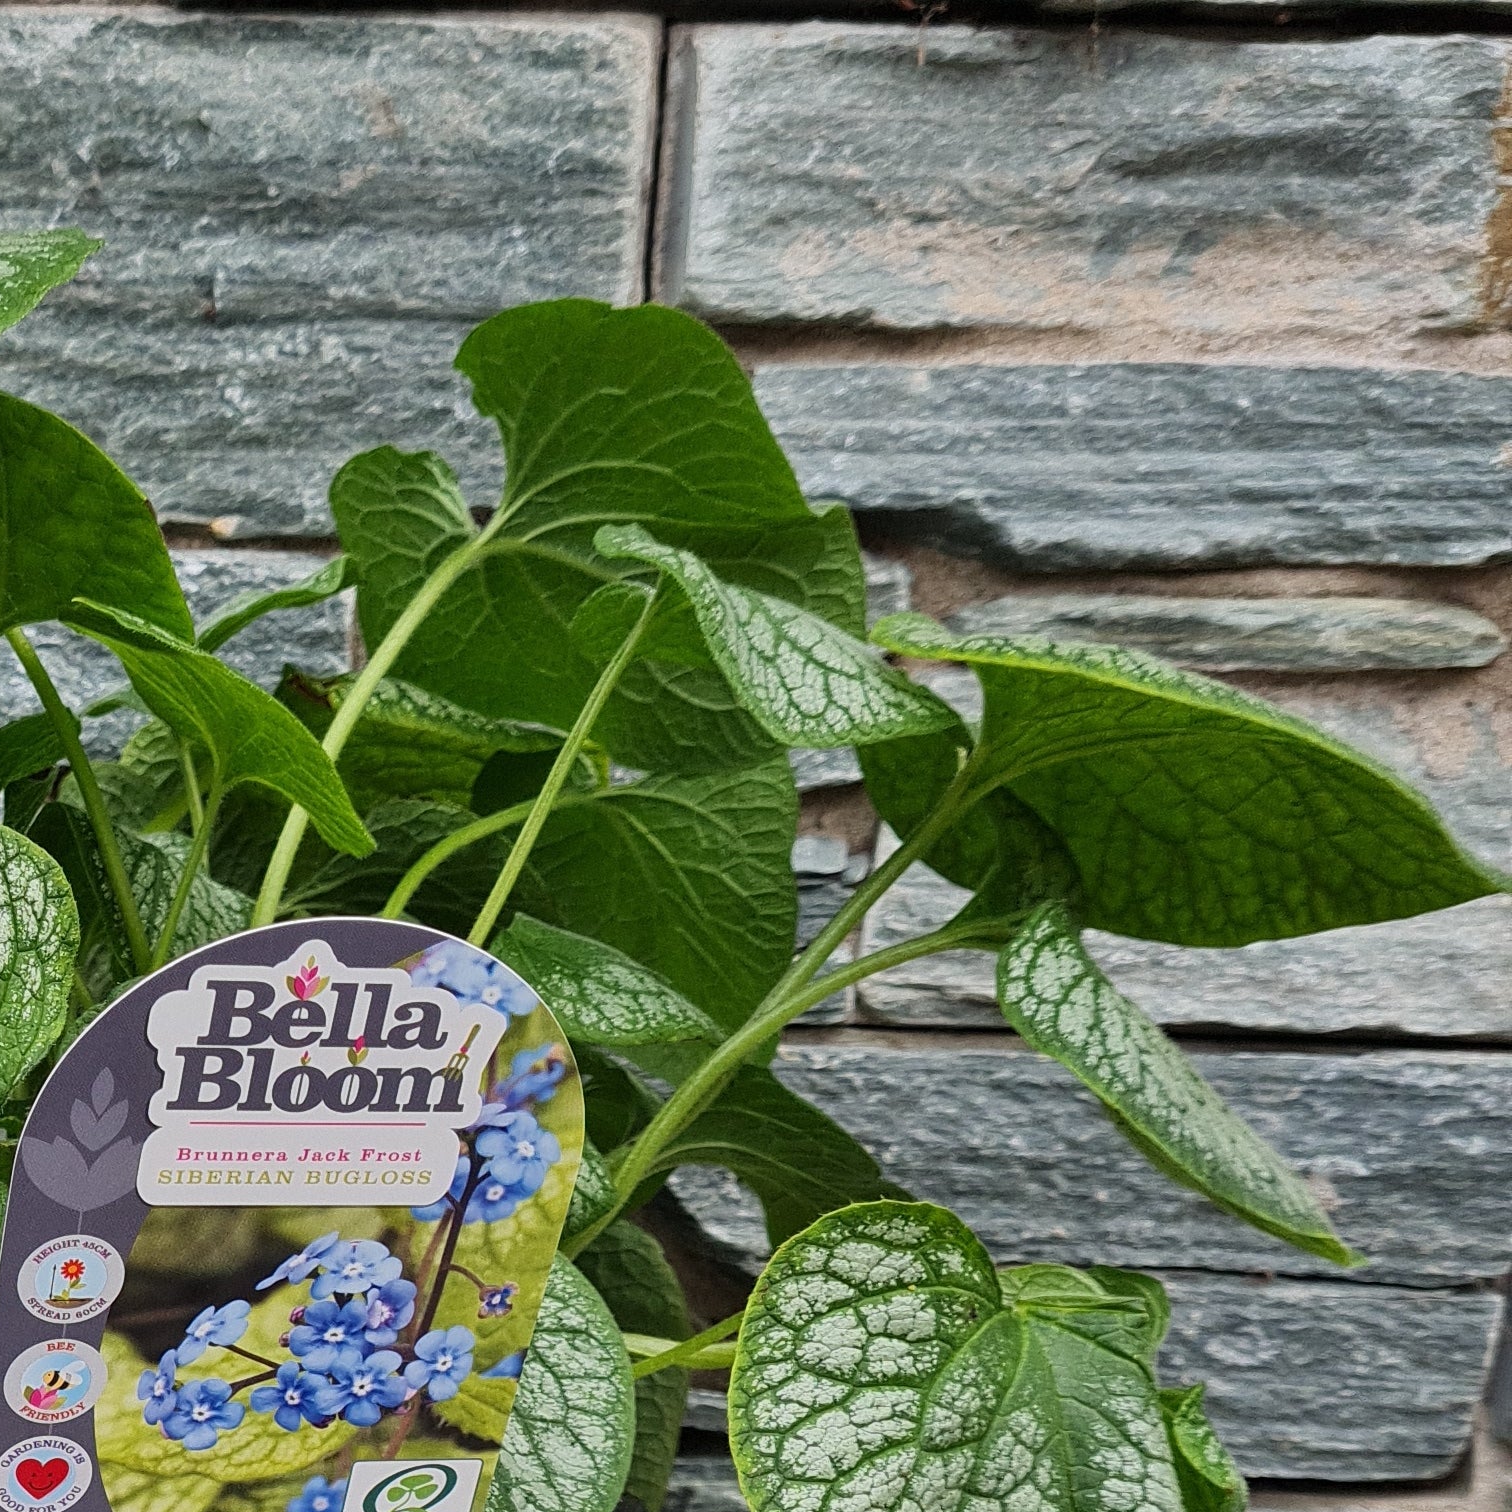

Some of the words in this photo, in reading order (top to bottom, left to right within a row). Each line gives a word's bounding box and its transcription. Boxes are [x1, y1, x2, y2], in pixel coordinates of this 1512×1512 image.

[196, 980, 448, 1050] Bella
[166, 1047, 465, 1113] Bloom
[176, 1147, 288, 1162] Brunnera
[298, 1148, 350, 1162] Jack
[360, 1148, 422, 1162] Frost
[157, 1169, 294, 1185] SIBERIAN
[304, 1169, 432, 1185] BUGLOSS
[32, 1239, 80, 1264] HEIGHT
[82, 1241, 112, 1261] 45CM
[27, 1297, 71, 1321] SPREAD
[75, 1297, 108, 1319] 60CM
[47, 1341, 76, 1352] BEE
[19, 1401, 86, 1422] FRIENDLY
[0, 1439, 76, 1468] GARDENING
[72, 1452, 85, 1465] IS
[58, 1485, 82, 1507] YOU
